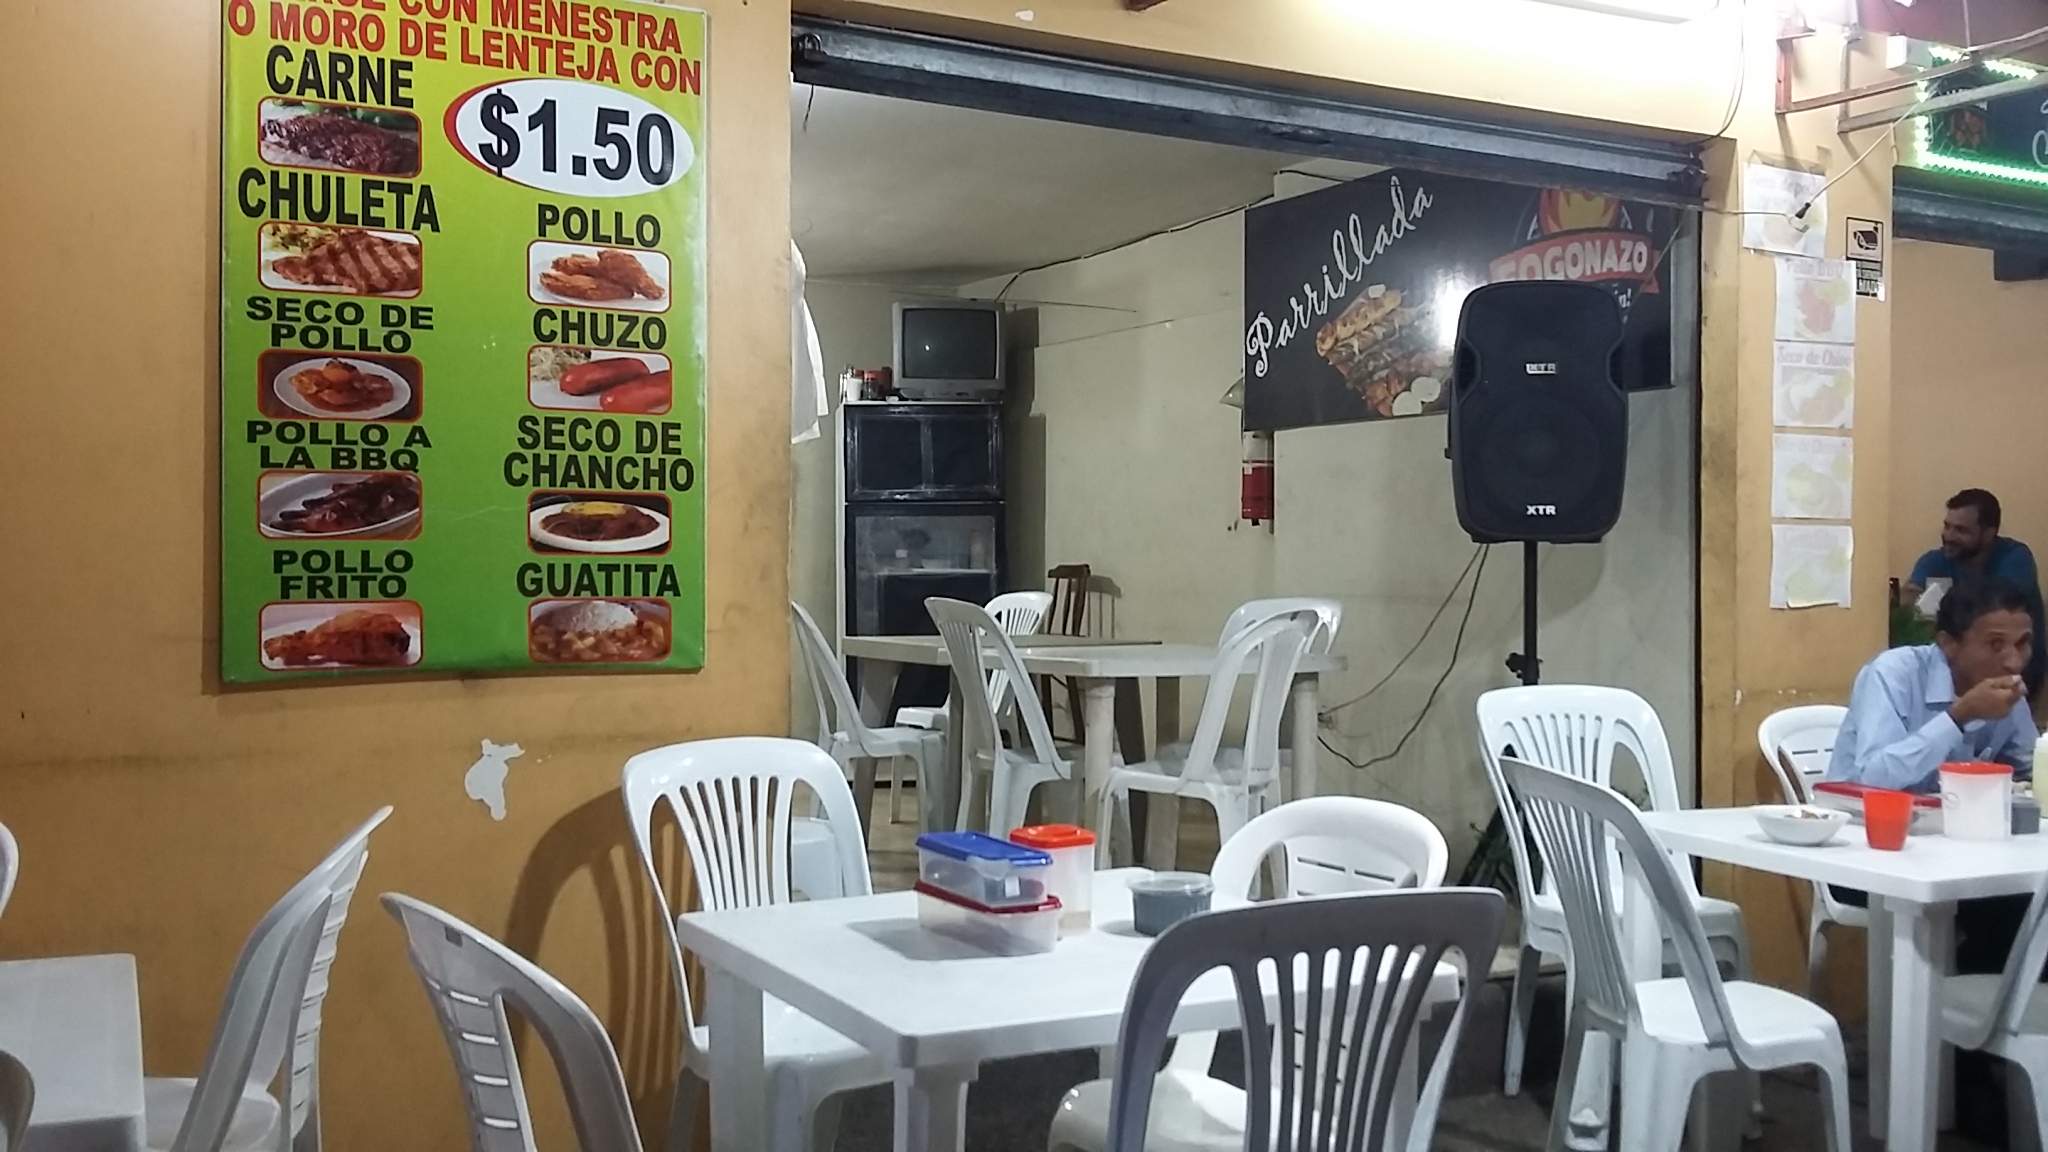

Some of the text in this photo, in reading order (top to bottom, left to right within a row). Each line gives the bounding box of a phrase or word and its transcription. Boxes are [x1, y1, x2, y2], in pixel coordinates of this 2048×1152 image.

[491, 0, 682, 54] MENESTRA
[228, 0, 700, 95] O MORO DE LENTEJA CON
[266, 45, 414, 108] CARNE
[478, 88, 675, 187] $1.50
[238, 167, 440, 232] CHULETA
[538, 203, 661, 247] POLLO
[1246, 175, 1433, 378] Parrillada
[246, 296, 433, 330] SECO DE
[533, 308, 667, 350] CHUZO
[271, 323, 411, 353] POLLO
[246, 420, 432, 448] POLLO A
[517, 416, 682, 455] SECO DE
[260, 445, 419, 472] LA BBQ
[503, 453, 694, 491] CHANCHO
[1526, 504, 1557, 516] XTR
[273, 549, 414, 574] POLLO
[516, 563, 681, 598] GUATITA
[279, 575, 407, 600] FRITO
